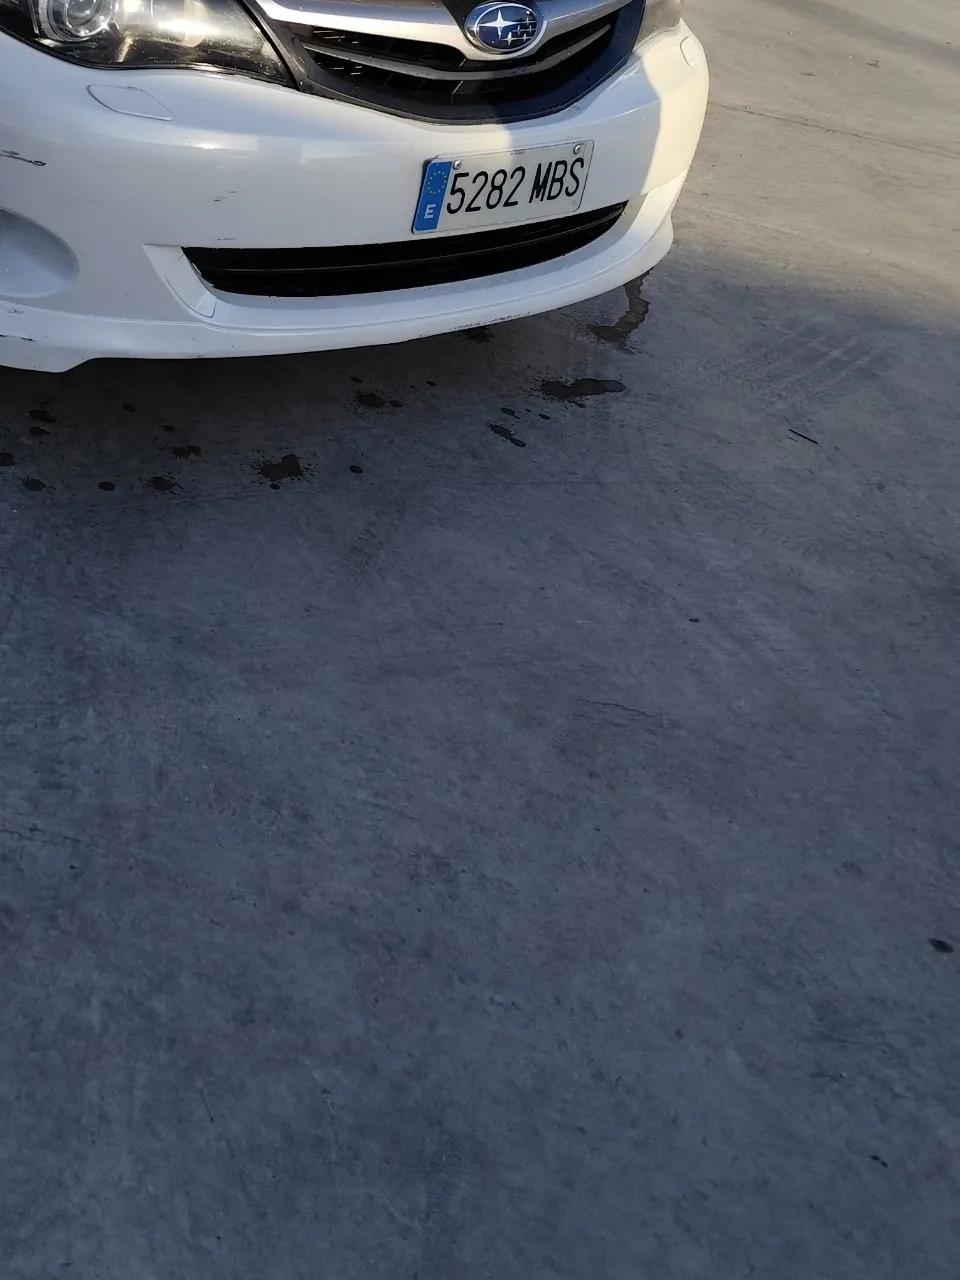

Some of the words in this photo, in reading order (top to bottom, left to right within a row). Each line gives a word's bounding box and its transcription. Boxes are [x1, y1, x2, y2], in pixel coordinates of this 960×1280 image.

[446, 165, 526, 215] 5282
[528, 157, 585, 204] MBS
[424, 203, 436, 219] E
